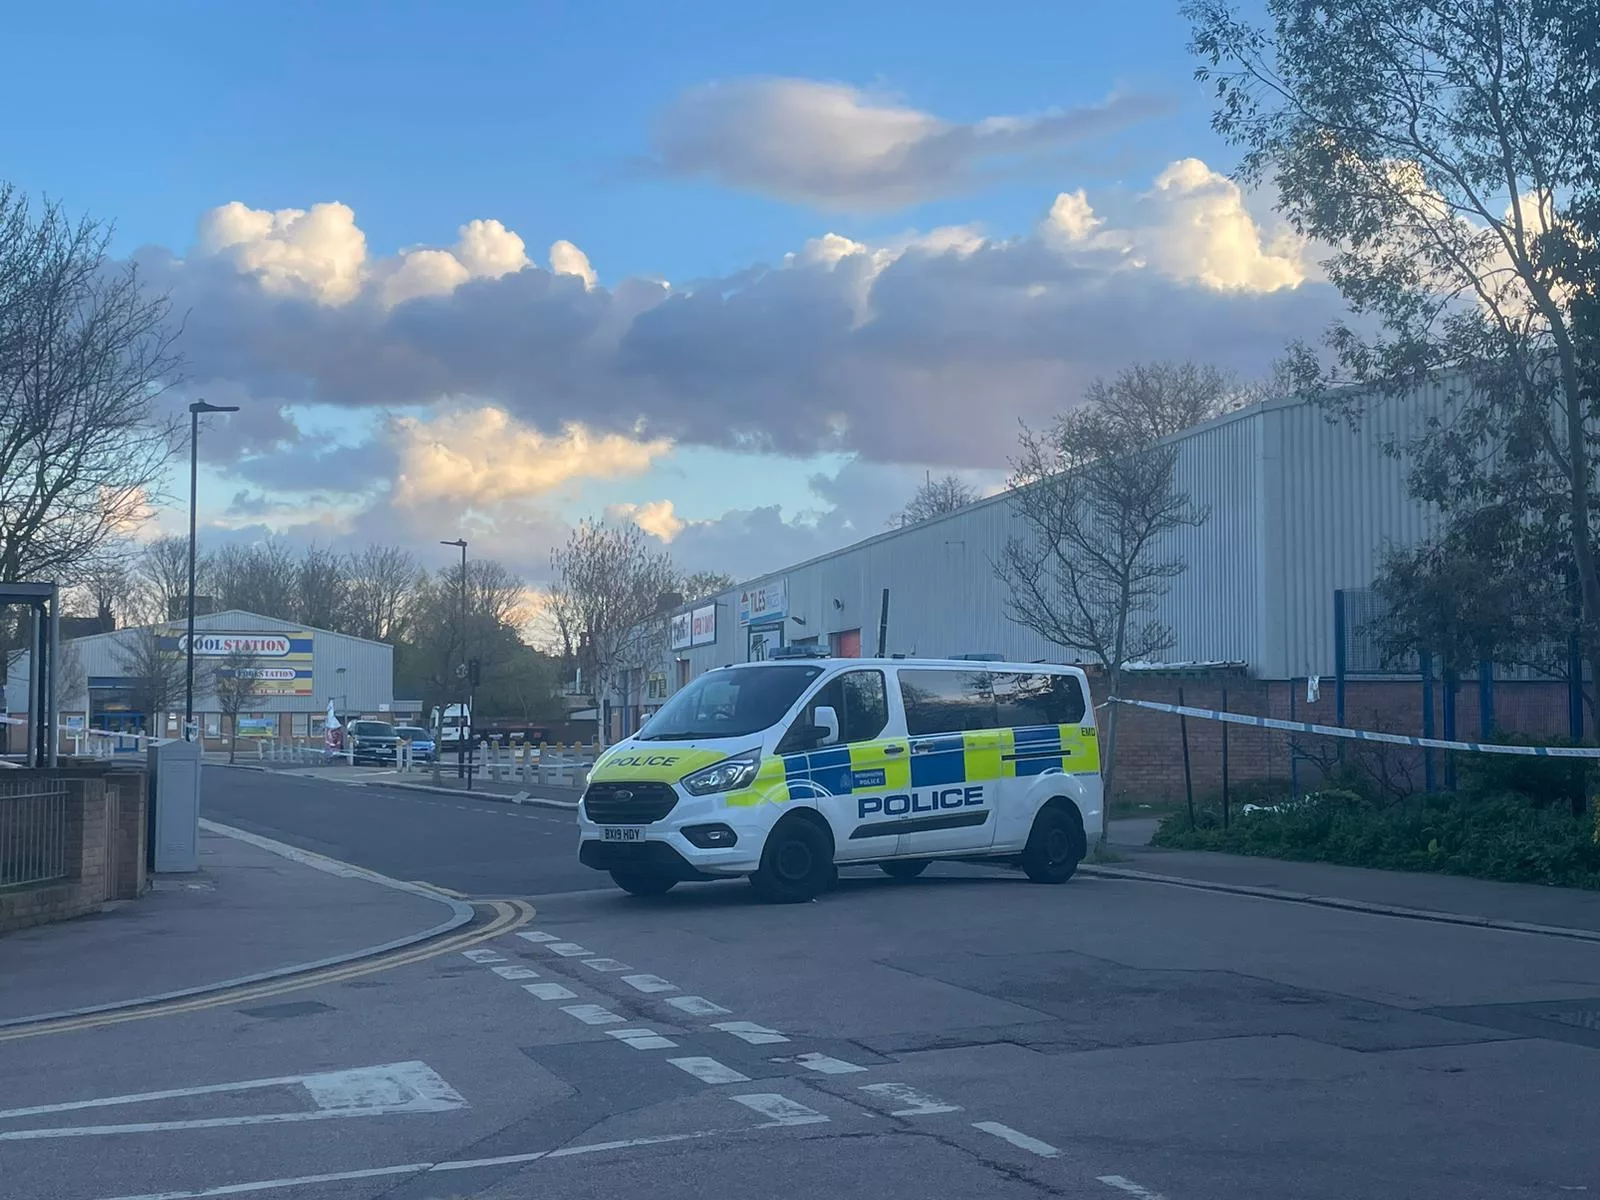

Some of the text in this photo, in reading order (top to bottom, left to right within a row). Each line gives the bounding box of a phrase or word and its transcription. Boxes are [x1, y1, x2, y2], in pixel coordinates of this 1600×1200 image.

[606, 756, 680, 767] POLICE
[858, 786, 984, 819] POLICE
[605, 829, 622, 840] BX19
